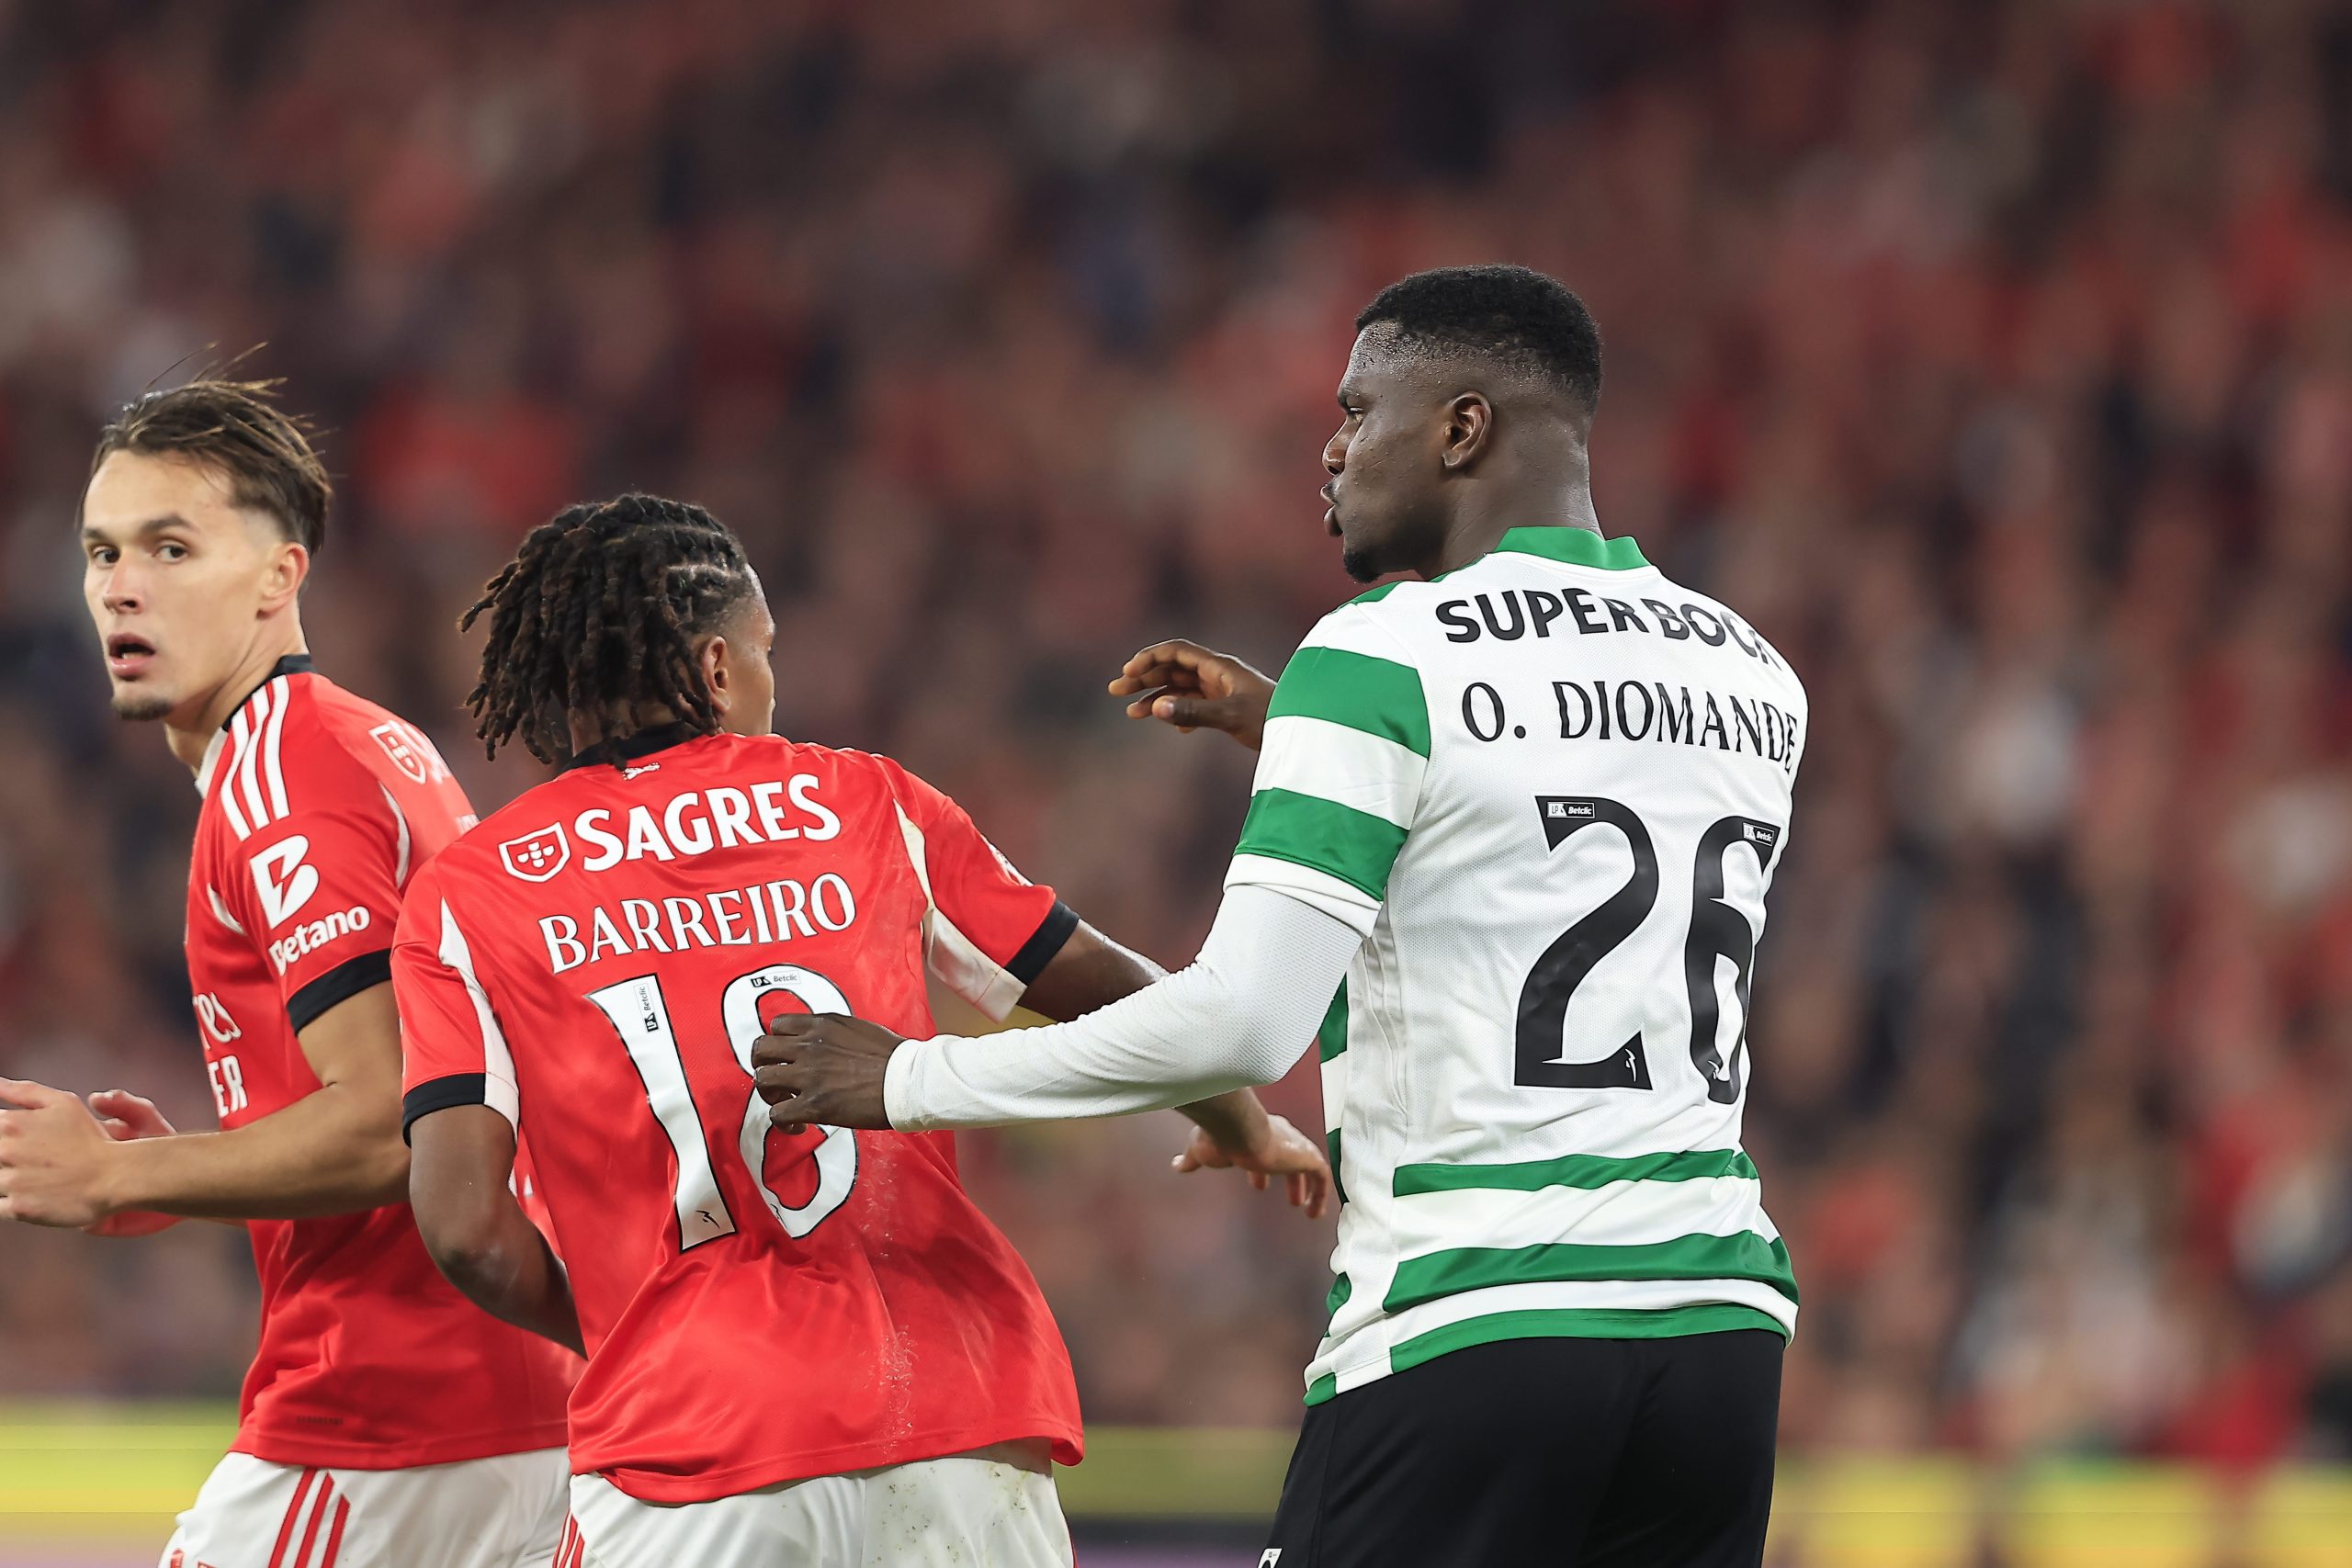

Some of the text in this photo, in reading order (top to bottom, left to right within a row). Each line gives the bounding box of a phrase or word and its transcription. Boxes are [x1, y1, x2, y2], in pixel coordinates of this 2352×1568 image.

[1435, 587, 1782, 671] SUPER BOCK
[1461, 681, 1797, 774] O. DIOMANDE
[574, 773, 842, 872] SAGRES
[268, 906, 370, 977] Betano
[538, 872, 856, 975] BARREIRO
[1514, 795, 1782, 1105] 26
[585, 964, 860, 1253] 18
